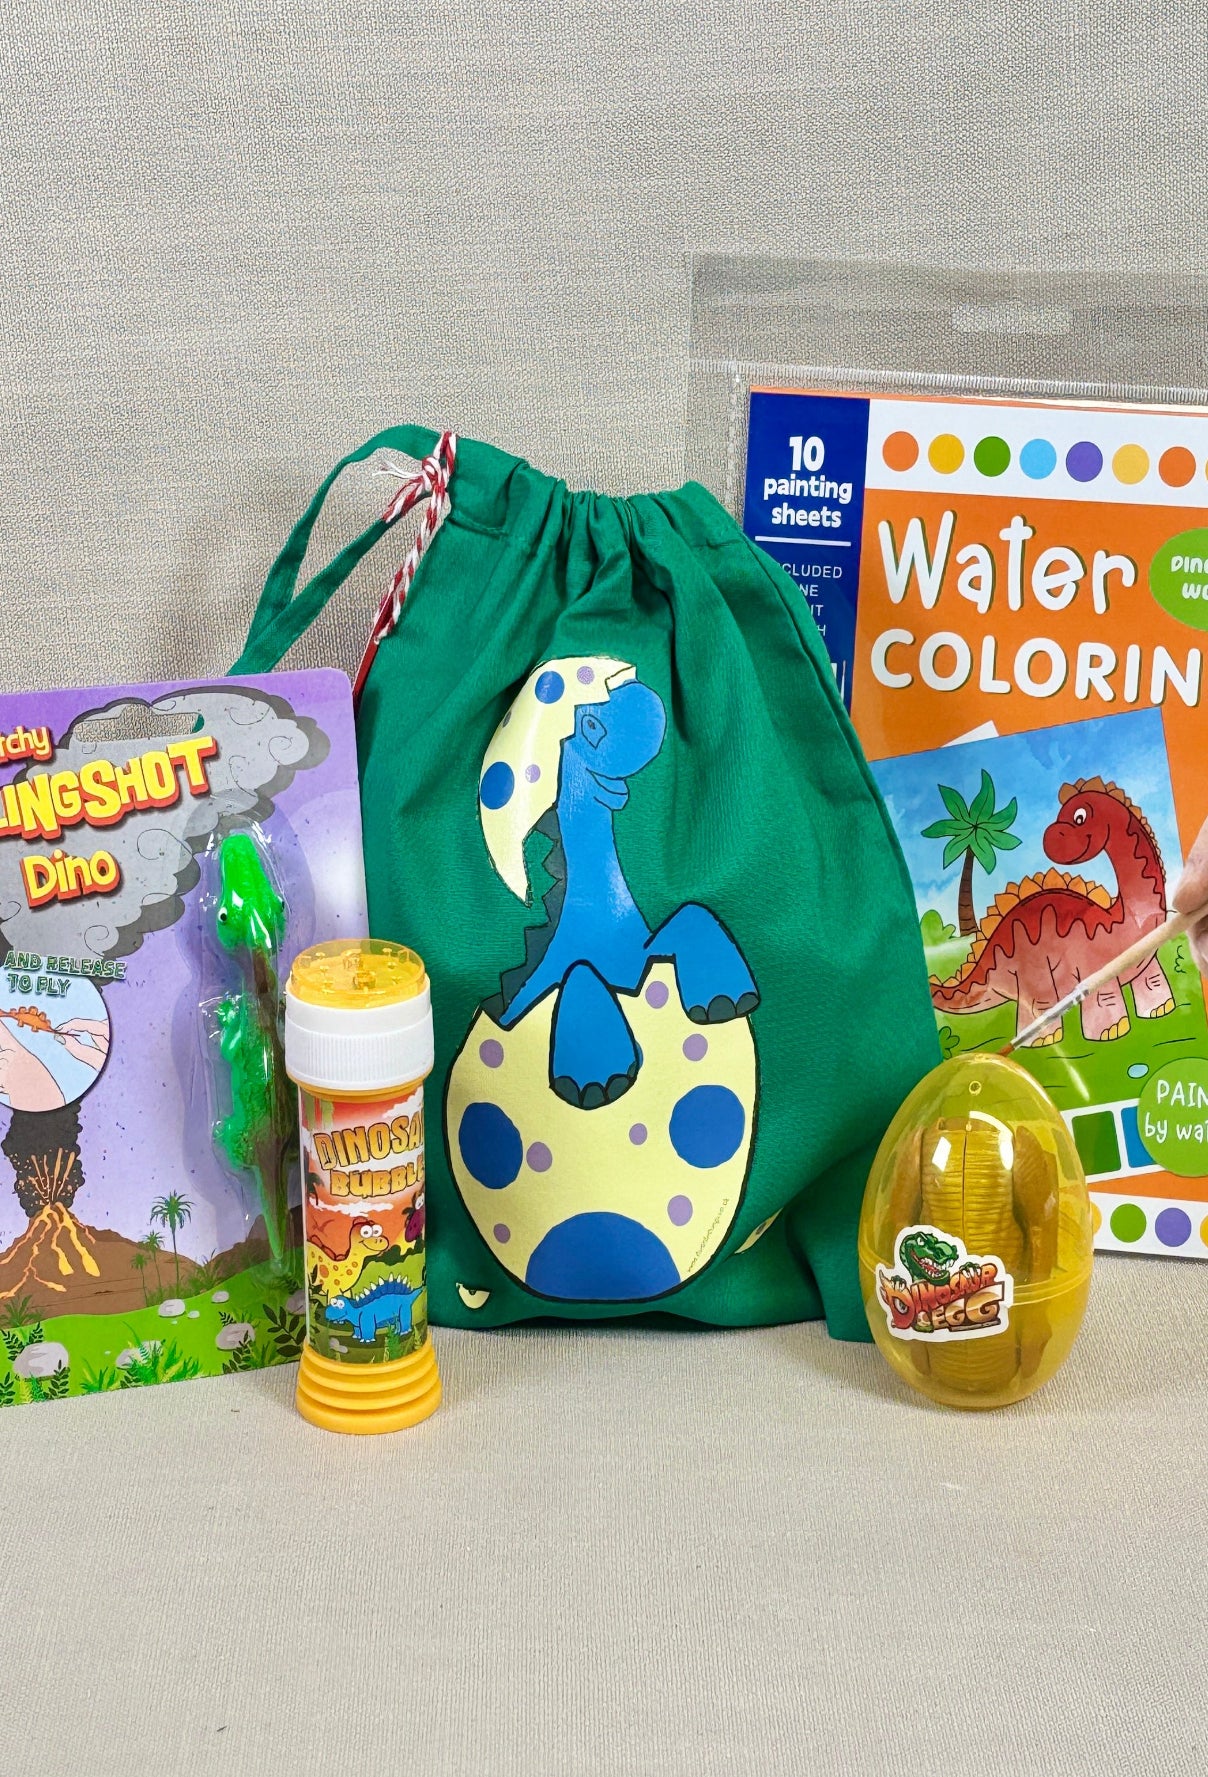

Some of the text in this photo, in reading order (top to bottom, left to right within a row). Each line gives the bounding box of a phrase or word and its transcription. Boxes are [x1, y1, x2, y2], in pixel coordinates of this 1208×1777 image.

[788, 435, 825, 472] 10
[763, 473, 853, 505] painting
[770, 505, 842, 529] sheets
[778, 563, 843, 579] CLUDED
[877, 509, 1138, 615] Water
[799, 583, 819, 597] NE
[870, 628, 1203, 707] COLORIN
[20, 849, 120, 908] Dino
[4, 951, 127, 981] AND RELEASE
[7, 973, 70, 997] TO FLY
[312, 1110, 424, 1171] DINOSA
[1145, 1112, 1168, 1144] by
[931, 1281, 1005, 1330] EGG
